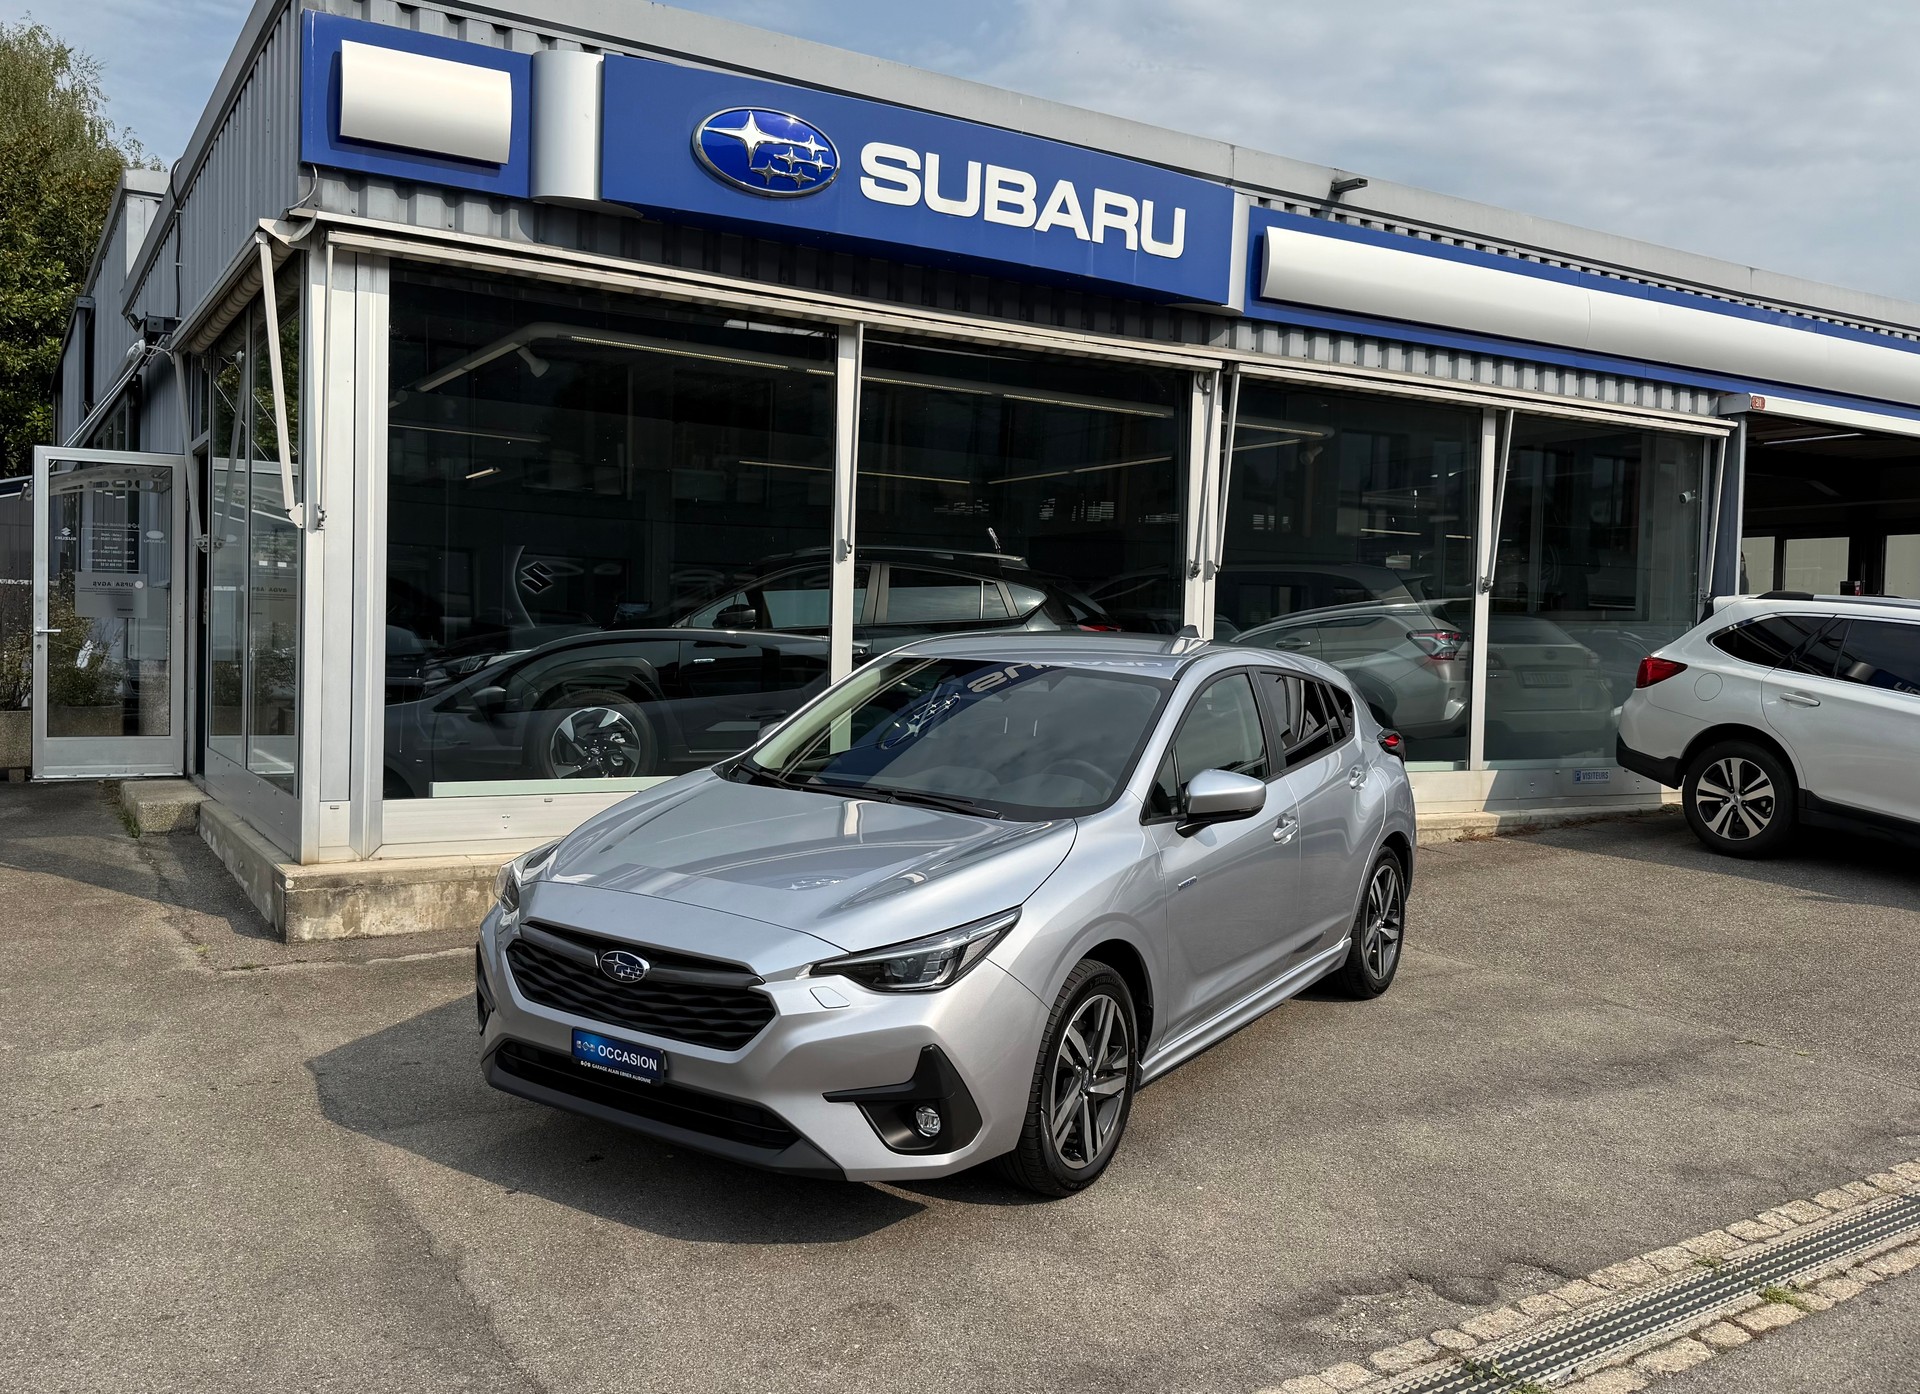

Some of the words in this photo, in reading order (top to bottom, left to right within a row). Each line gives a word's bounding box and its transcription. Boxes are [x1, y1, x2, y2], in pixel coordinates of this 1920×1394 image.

[859, 141, 1187, 260] SUBARU
[1582, 771, 1609, 780] VISITEURS
[597, 1044, 657, 1071] OCCASION
[591, 1063, 608, 1072] GARAGE
